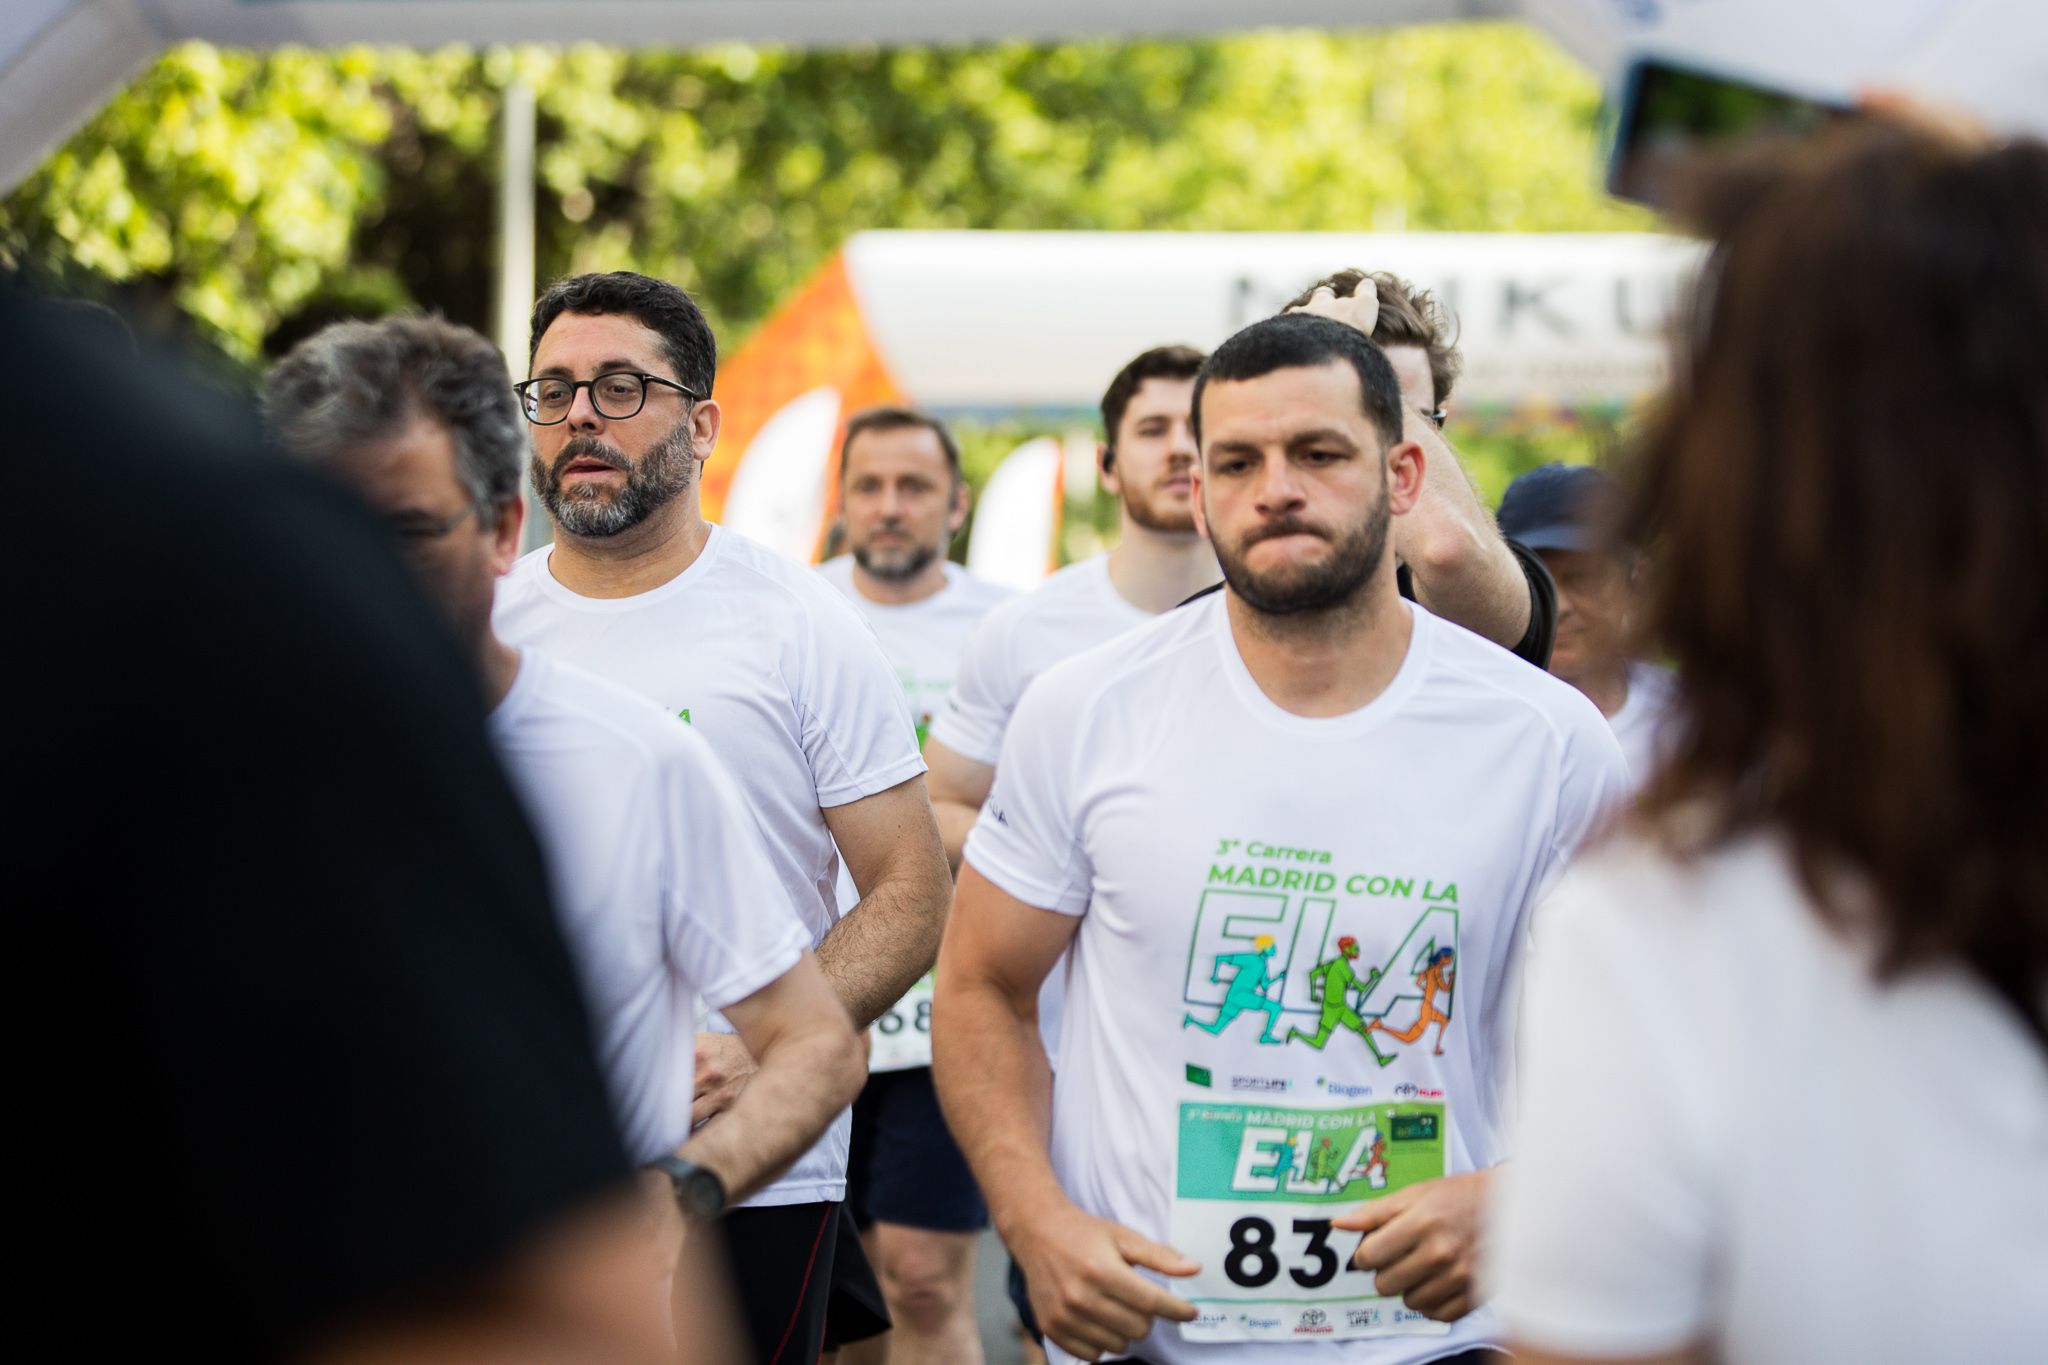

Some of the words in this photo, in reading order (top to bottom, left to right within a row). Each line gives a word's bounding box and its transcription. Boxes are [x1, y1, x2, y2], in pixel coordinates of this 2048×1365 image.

[1247, 841, 1333, 864] Carrera
[1207, 864, 1338, 893] MADRID
[1345, 874, 1415, 898] CON
[1422, 880, 1460, 904] LA
[1184, 888, 1460, 1020] ELA
[1246, 1111, 1314, 1129] MADRID
[1318, 1114, 1355, 1130] CON
[1358, 1111, 1376, 1126] LA
[1232, 1126, 1388, 1195] ELA
[1224, 1216, 1376, 1289] 83
